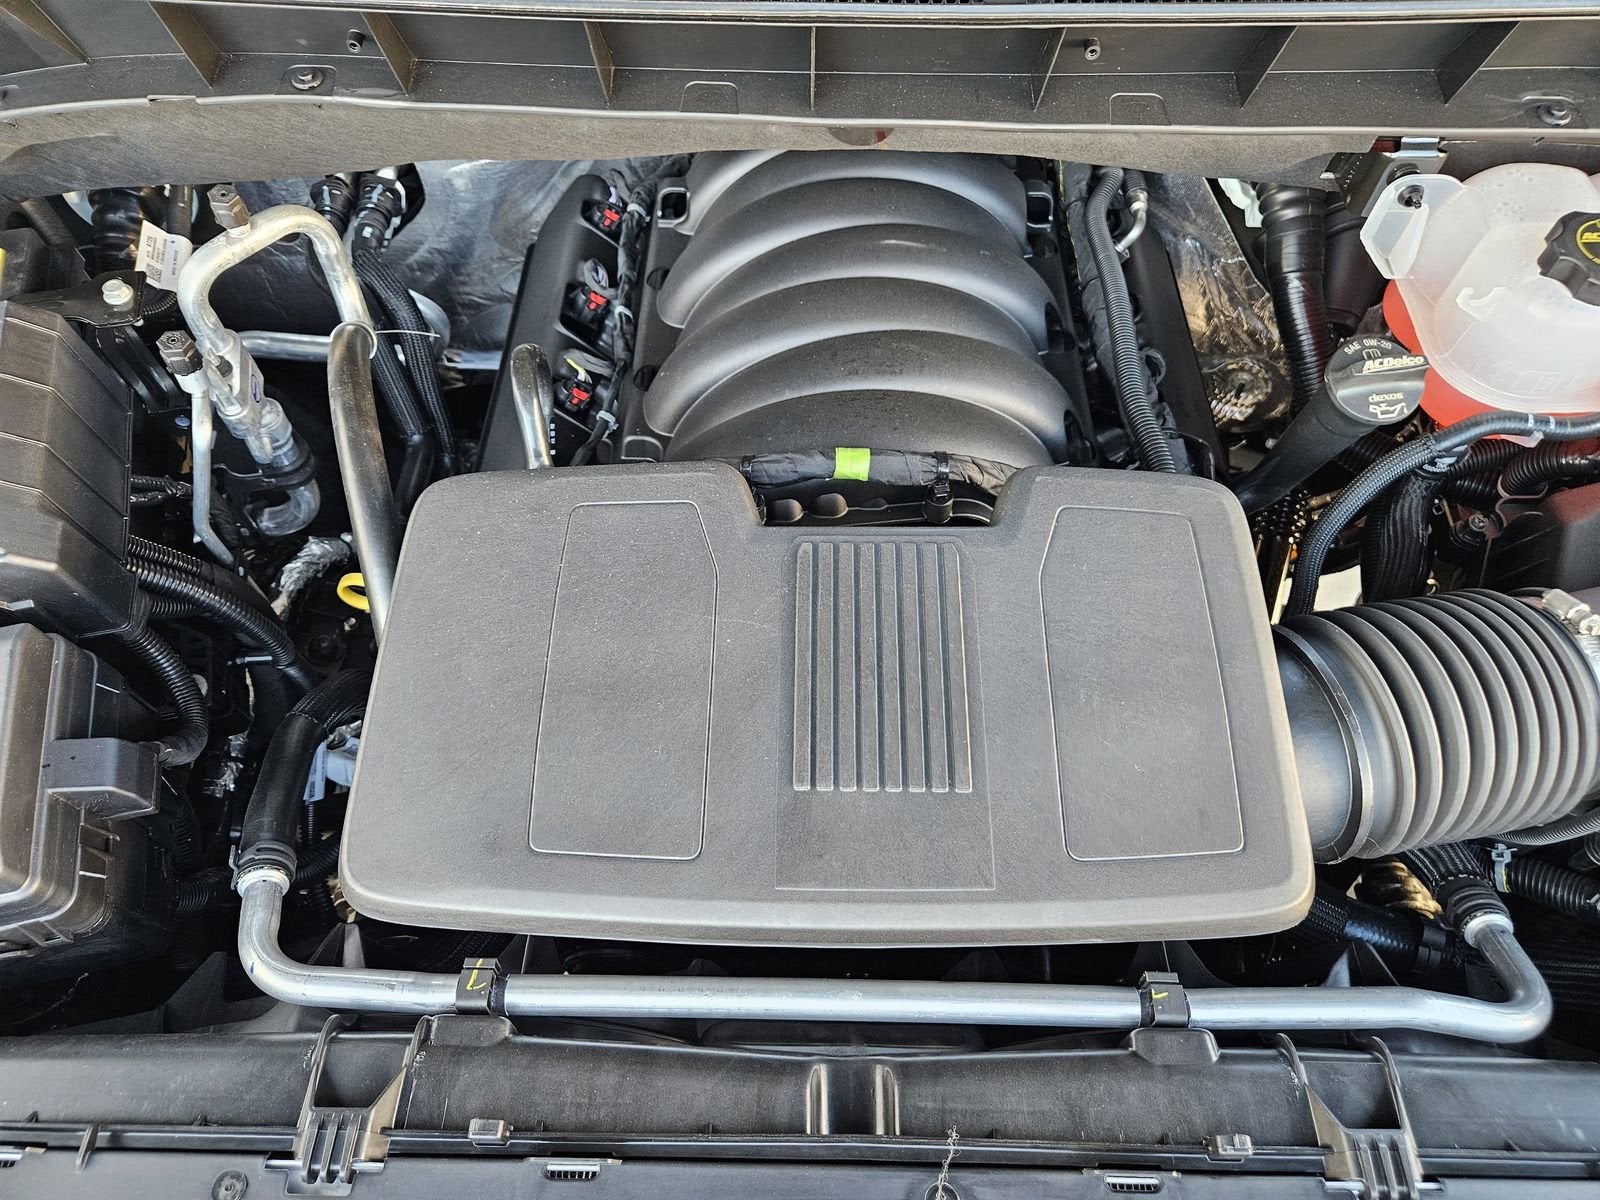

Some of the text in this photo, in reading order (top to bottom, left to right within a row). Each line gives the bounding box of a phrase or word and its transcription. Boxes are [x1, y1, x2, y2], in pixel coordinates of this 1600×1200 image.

[1344, 338, 1392, 355] SAE 0W-20
[1362, 355, 1425, 372] ACDelco
[1368, 392, 1404, 402] dexos
